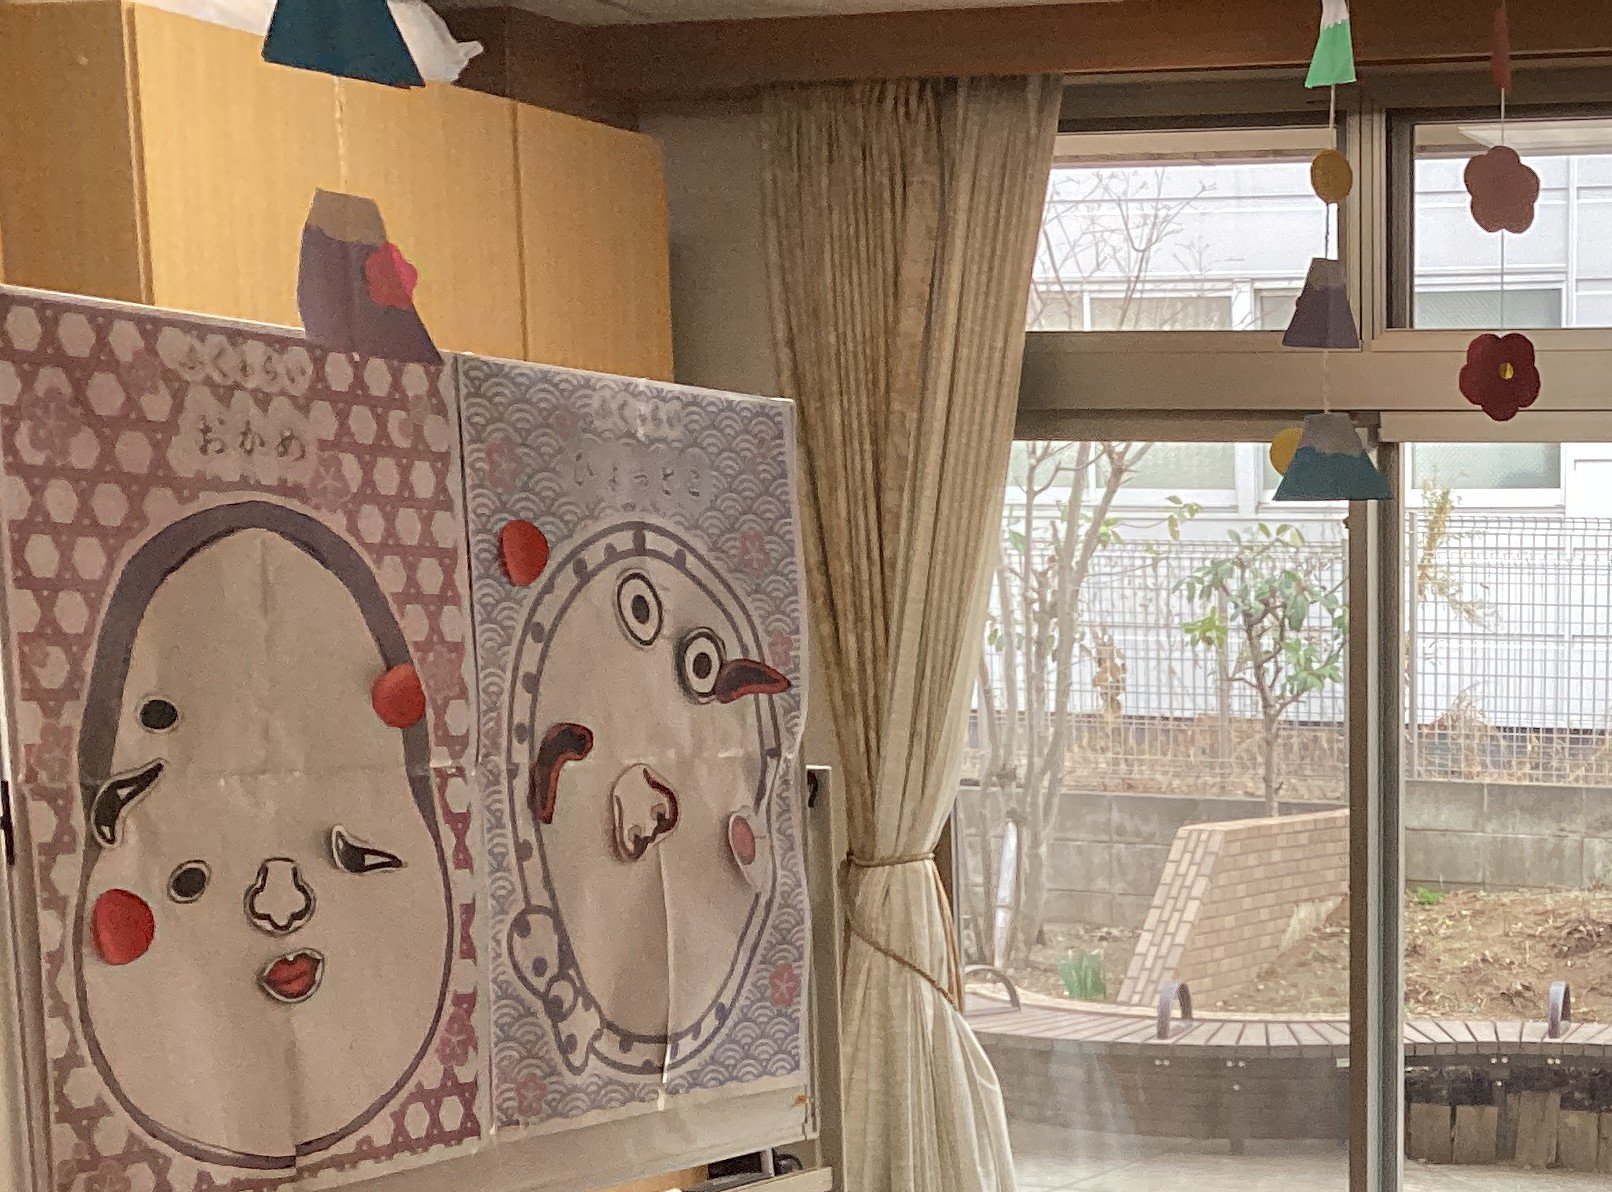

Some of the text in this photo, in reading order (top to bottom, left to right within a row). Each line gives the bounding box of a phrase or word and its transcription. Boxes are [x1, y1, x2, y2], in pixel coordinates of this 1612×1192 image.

[199, 414, 306, 462] おかめ
[574, 452, 700, 497] ひょっとこ
